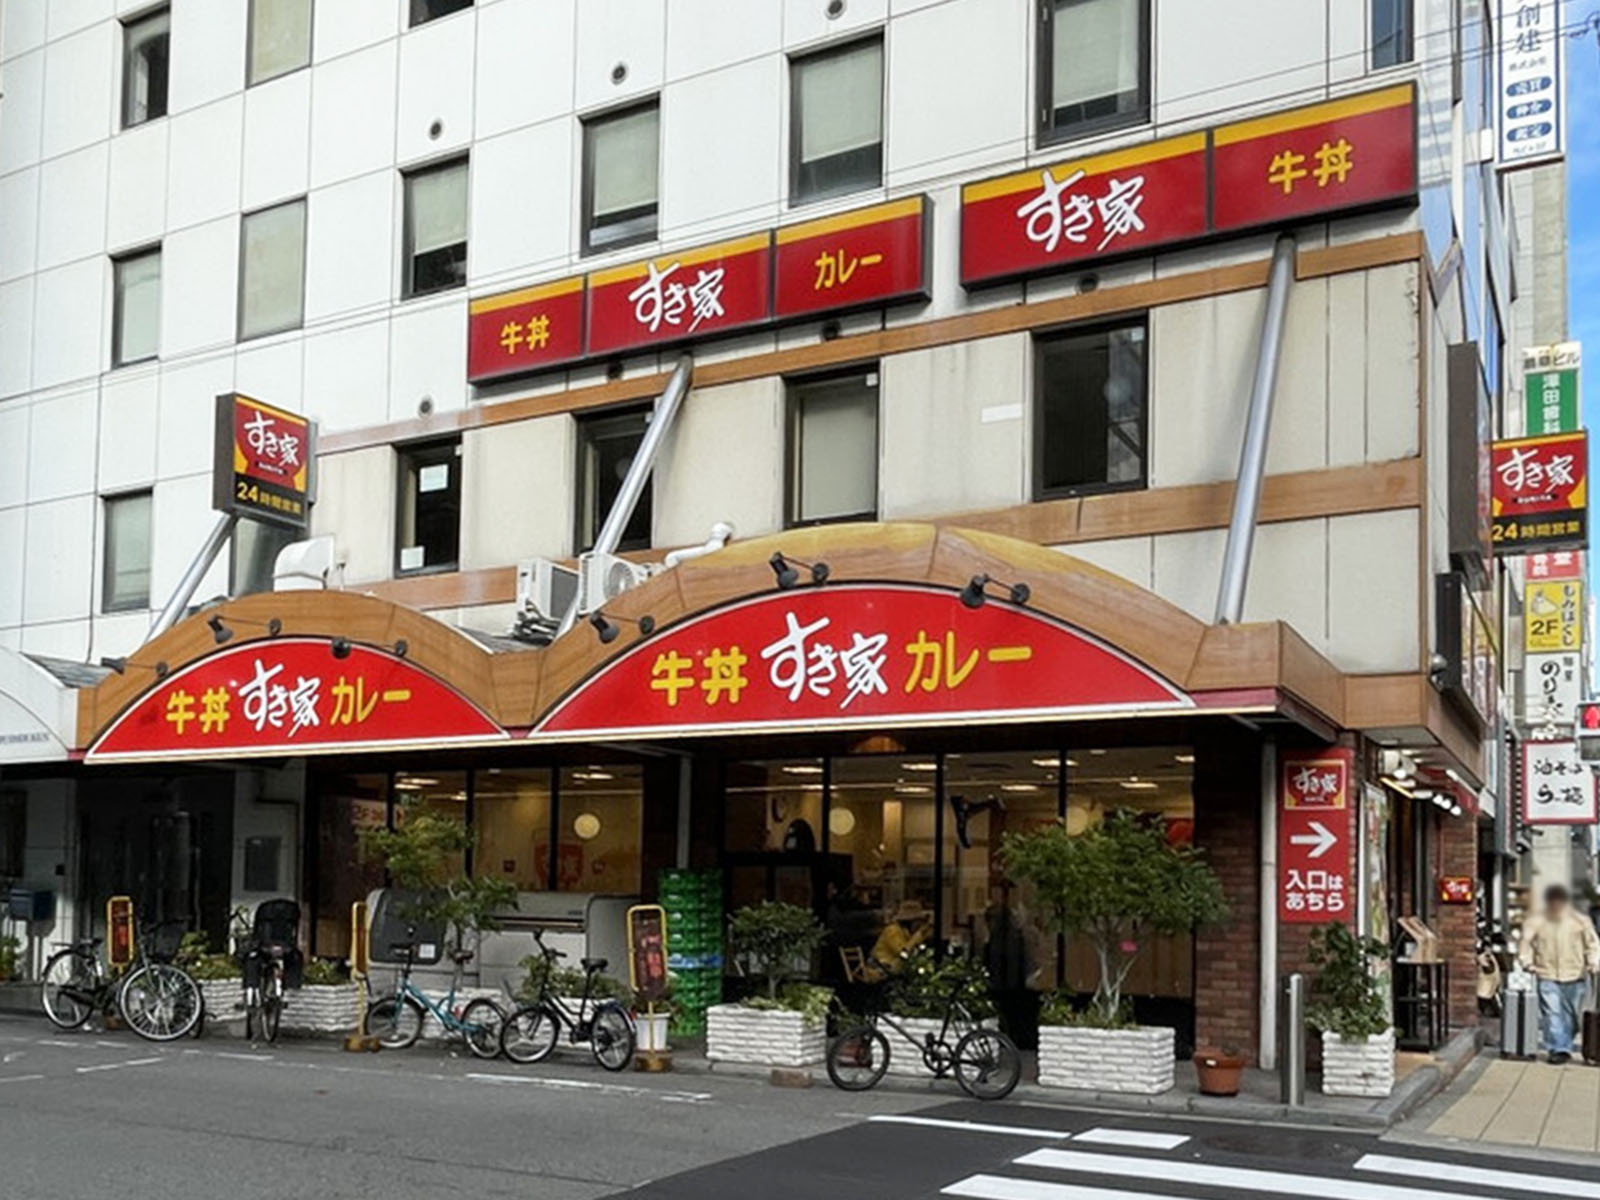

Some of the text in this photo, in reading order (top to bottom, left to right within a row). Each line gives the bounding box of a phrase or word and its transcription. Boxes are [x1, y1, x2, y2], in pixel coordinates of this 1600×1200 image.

[1268, 138, 1353, 194] 牛丼
[1016, 168, 1145, 253] すき家
[814, 248, 883, 290] カレー
[628, 261, 725, 333] すき家
[500, 315, 550, 354] 牛丼
[244, 411, 299, 467] すき家
[1497, 448, 1574, 493] すき家
[1531, 618, 1558, 636] 2F
[650, 611, 1032, 709] 牛丼 すき家 カレー
[165, 659, 411, 738] 牛丼 すき家 カレー
[1292, 767, 1338, 797] すき家
[1285, 869, 1343, 891] 入口は
[1285, 892, 1344, 912] あちら
